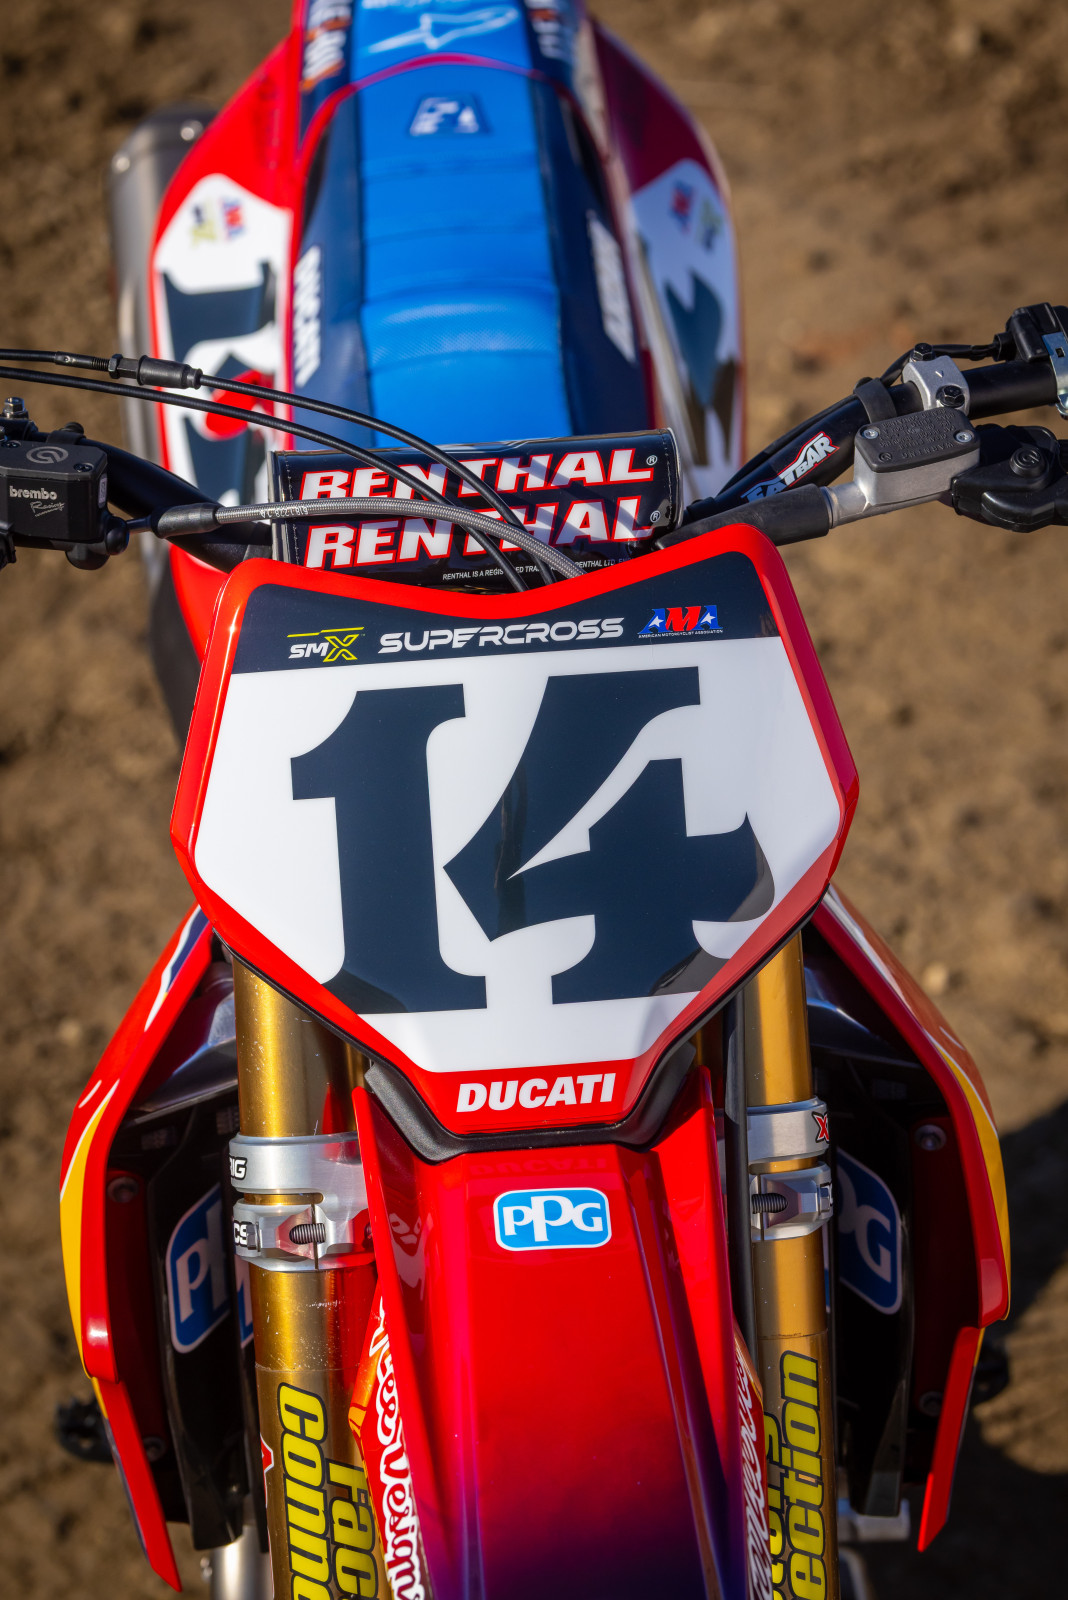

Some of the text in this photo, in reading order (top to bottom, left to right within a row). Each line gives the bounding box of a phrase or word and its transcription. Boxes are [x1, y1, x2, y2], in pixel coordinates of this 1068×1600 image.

[9, 486, 57, 500] brembo
[30, 501, 65, 513] Racing
[442, 571, 472, 580] RENTHAL
[378, 617, 624, 654] SUPERCROSS
[637, 605, 723, 634] AMA
[288, 634, 359, 662] SMX
[290, 666, 775, 1014] 14
[456, 1073, 616, 1113] DUCATI
[502, 1195, 604, 1243] PPG
[780, 1350, 827, 1600] ection
